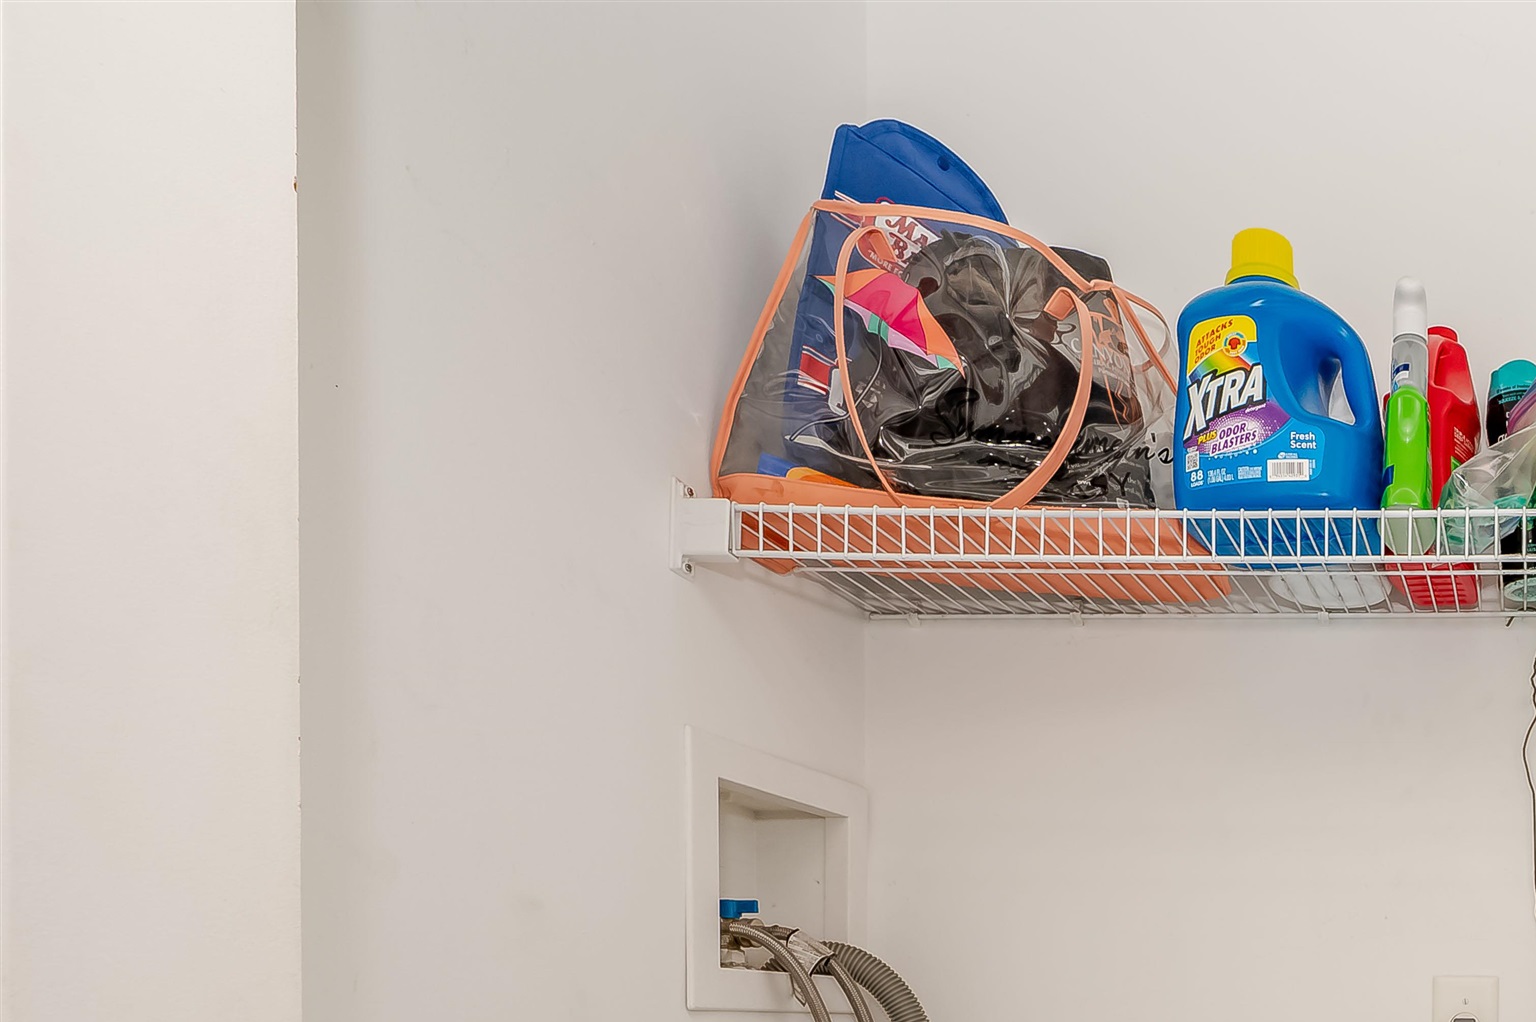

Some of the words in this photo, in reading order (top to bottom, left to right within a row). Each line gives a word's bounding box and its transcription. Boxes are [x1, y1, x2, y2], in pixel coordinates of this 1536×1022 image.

[1195, 333, 1222, 356] TOUGH
[1196, 319, 1234, 348] ATTACKS
[1194, 344, 1216, 364] ODOR
[1183, 364, 1265, 440] XTRA
[1198, 430, 1218, 445] PLUS
[1218, 422, 1247, 440] ODOR
[1211, 430, 1257, 455] BLASTERS
[1290, 431, 1316, 440] Fresh
[1290, 440, 1317, 449] Scent
[1190, 470, 1204, 482] 88
